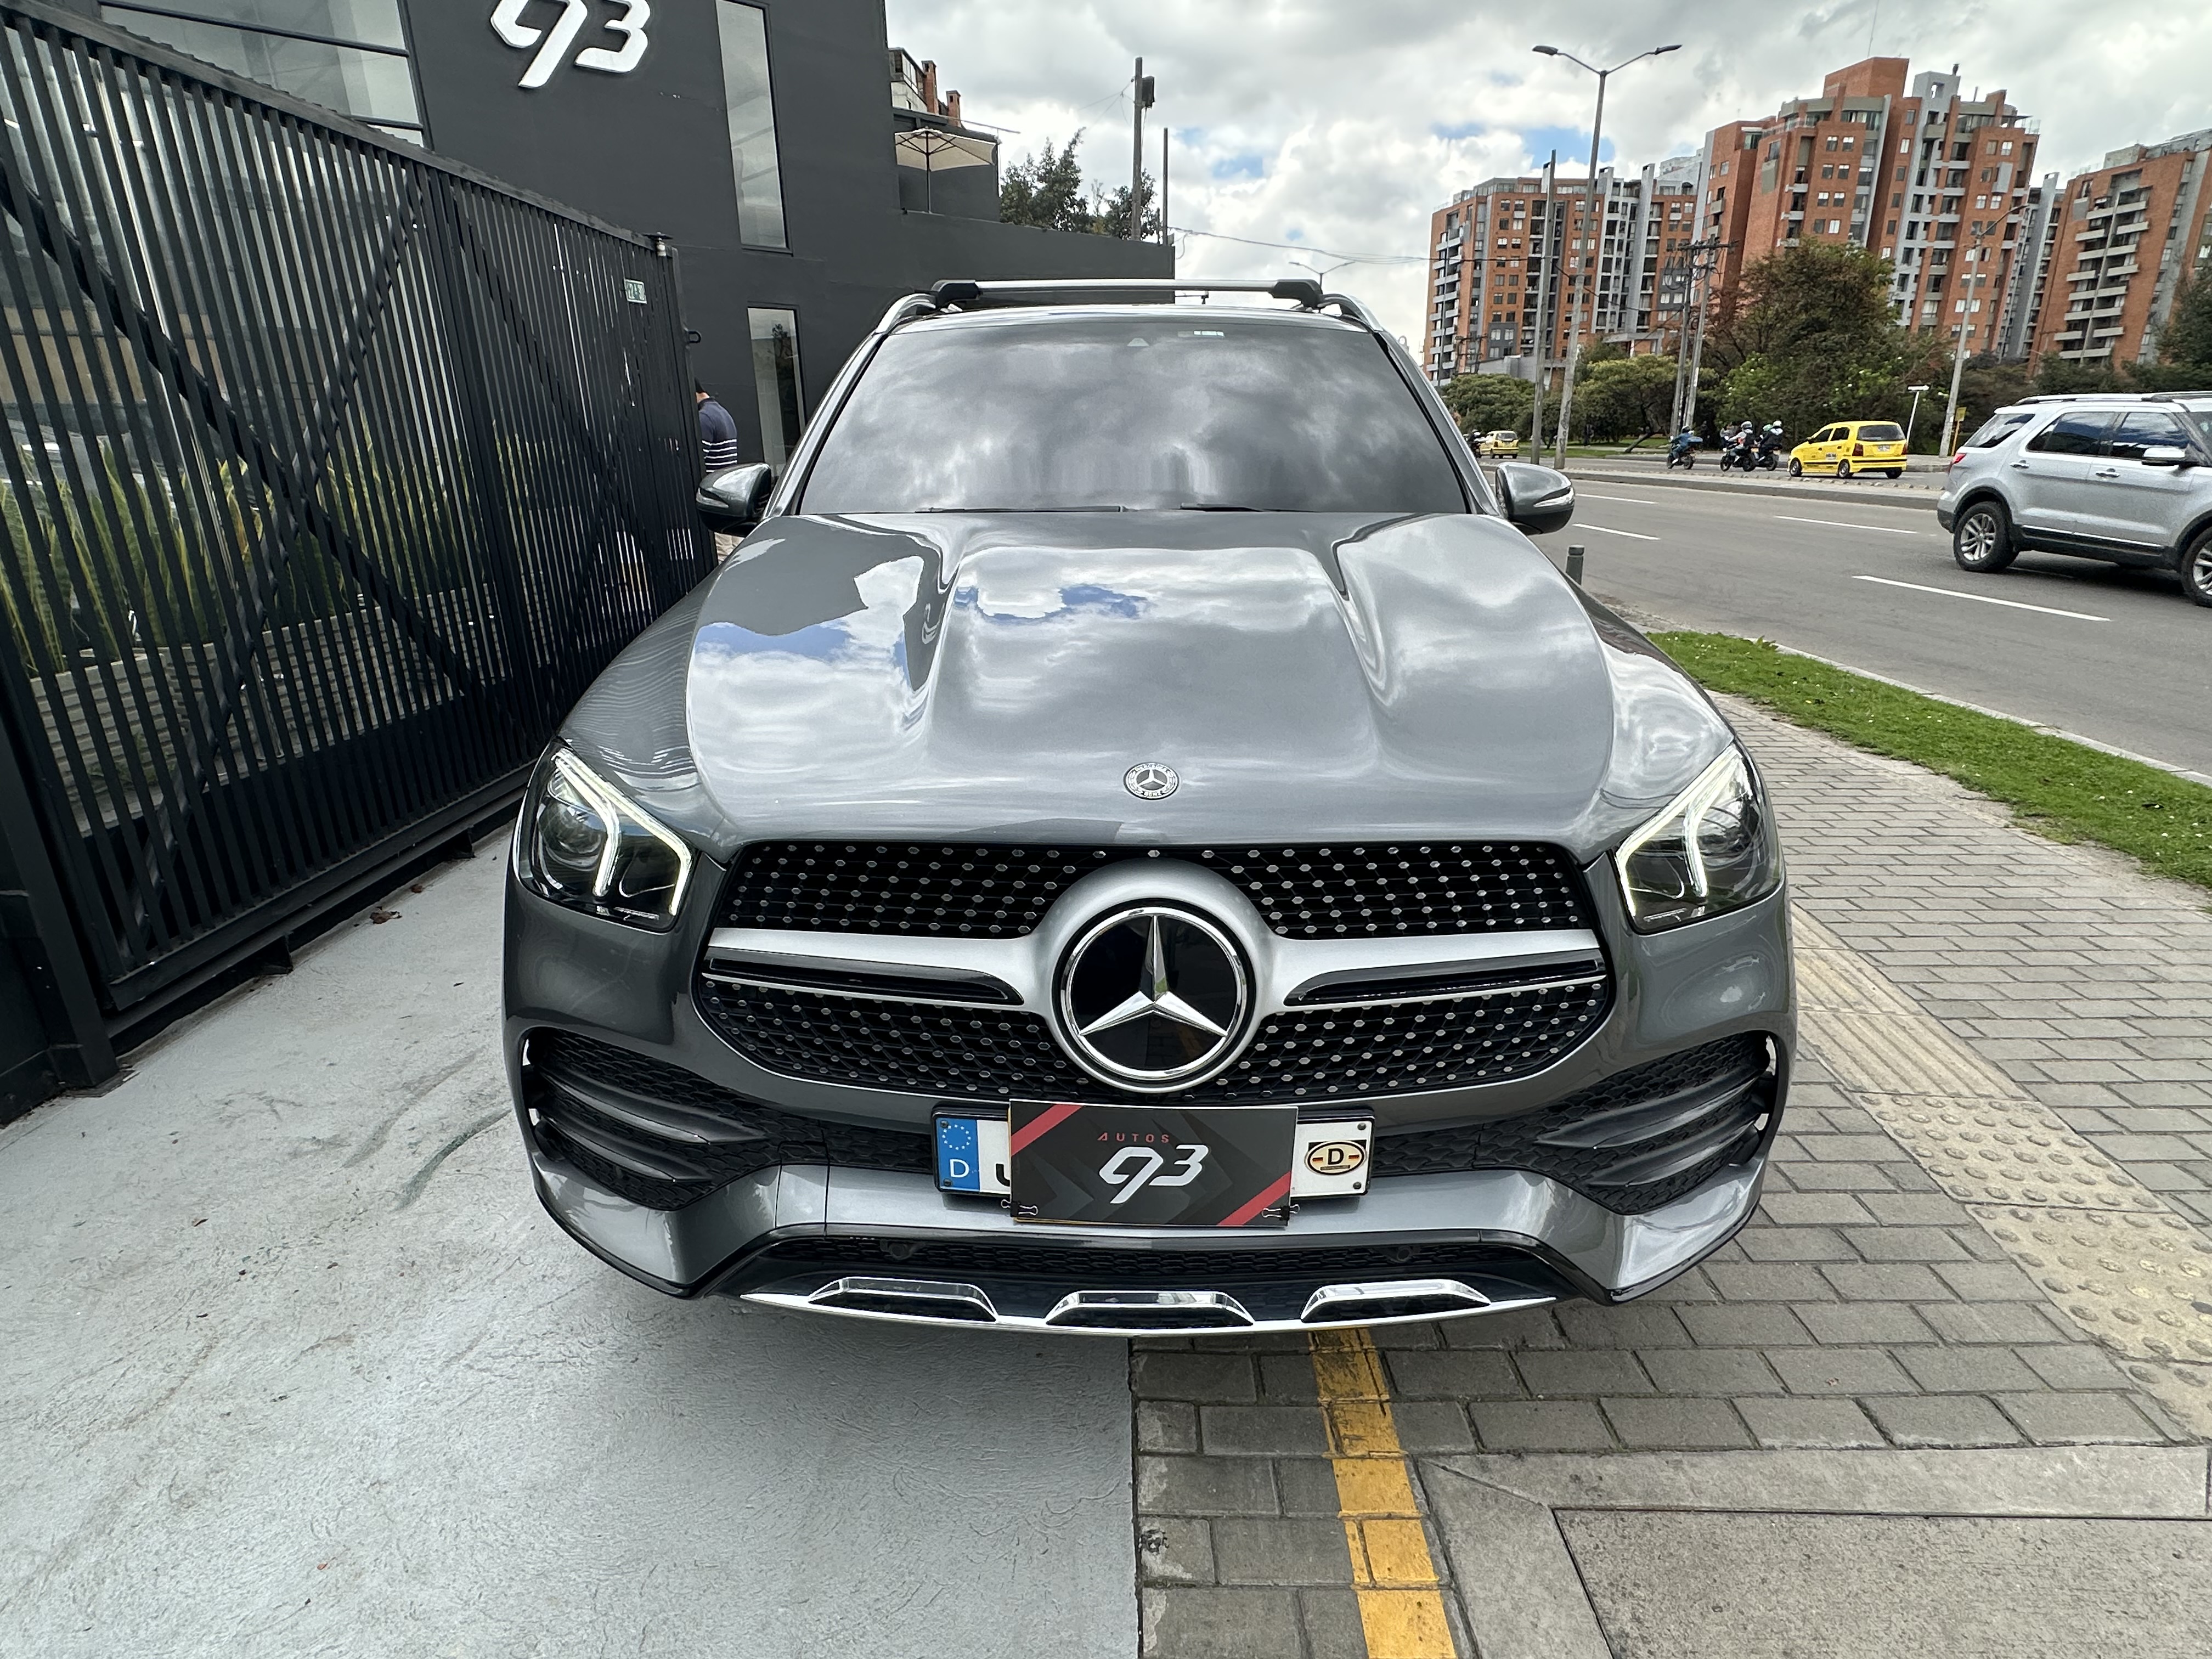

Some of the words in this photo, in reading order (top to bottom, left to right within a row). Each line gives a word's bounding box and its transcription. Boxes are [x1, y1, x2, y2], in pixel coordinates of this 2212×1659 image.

[490, 0, 651, 88] 93
[1097, 1132, 1170, 1143] AUTOS
[1328, 1148, 1344, 1165] D
[949, 1159, 969, 1178] D
[1099, 1144, 1209, 1204] 93
